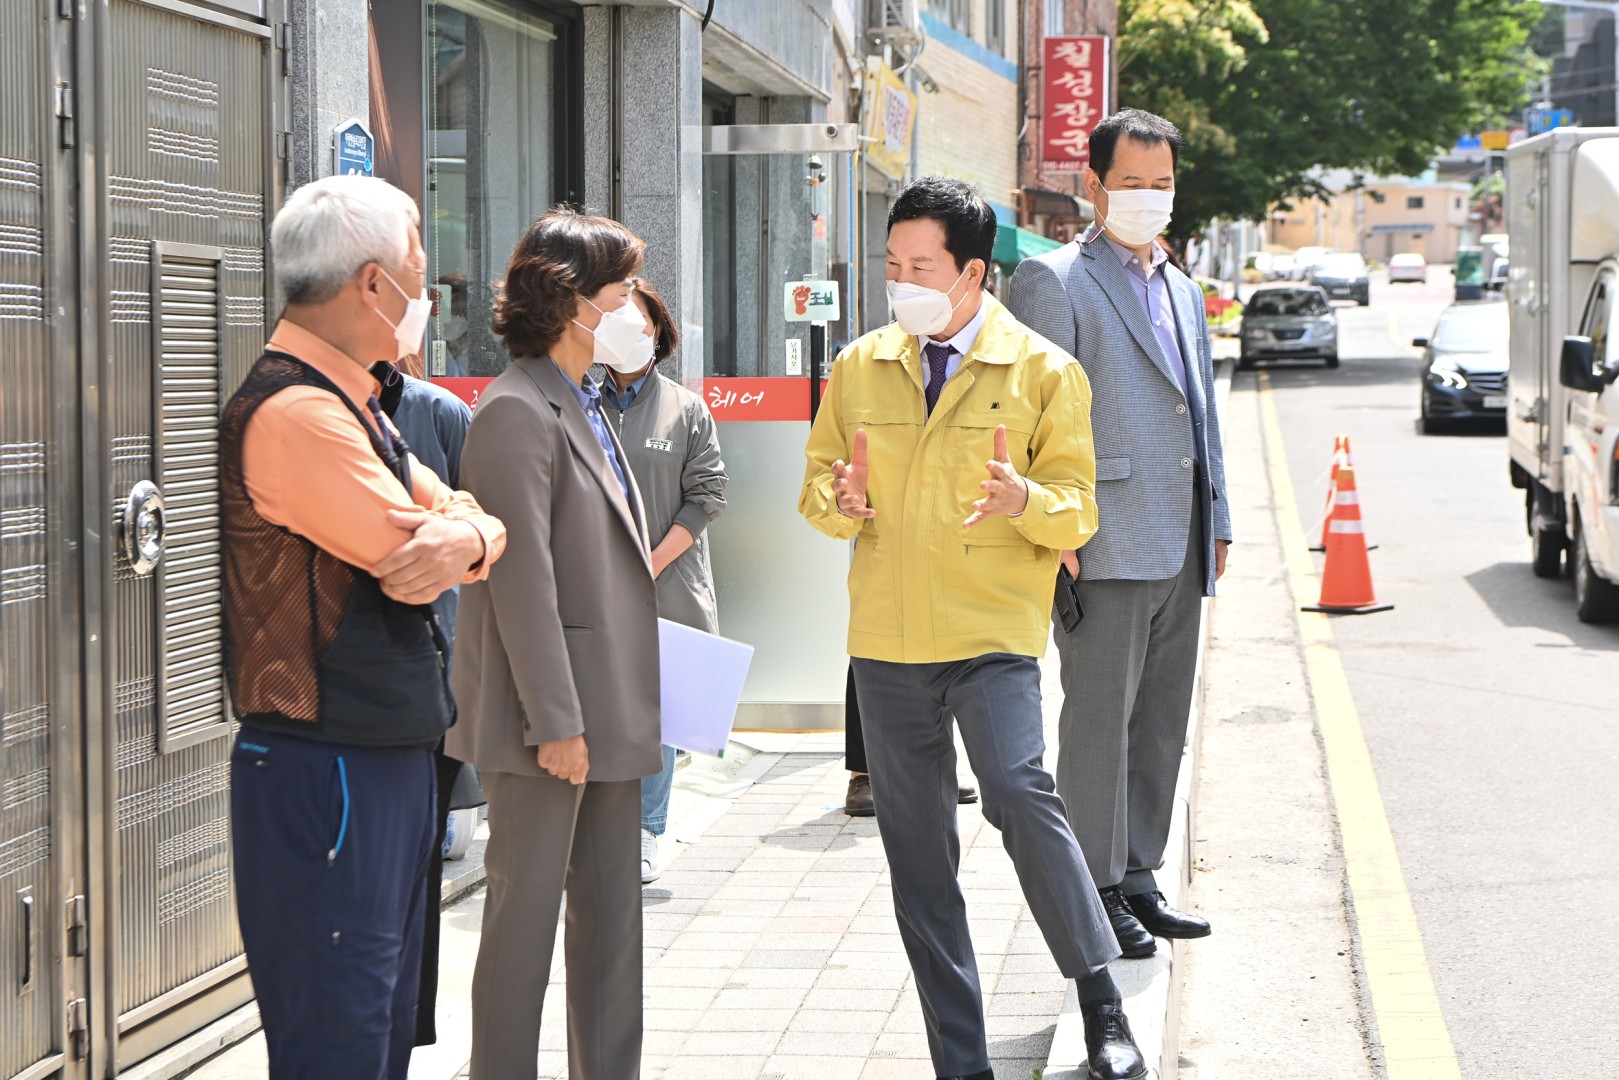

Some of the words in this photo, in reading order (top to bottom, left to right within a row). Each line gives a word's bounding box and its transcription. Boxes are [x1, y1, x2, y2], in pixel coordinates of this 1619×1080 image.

[1048, 40, 1097, 157] 칠성장군
[808, 290, 834, 306] 조심
[790, 341, 798, 367] 당기시오
[708, 385, 765, 409] 헤어
